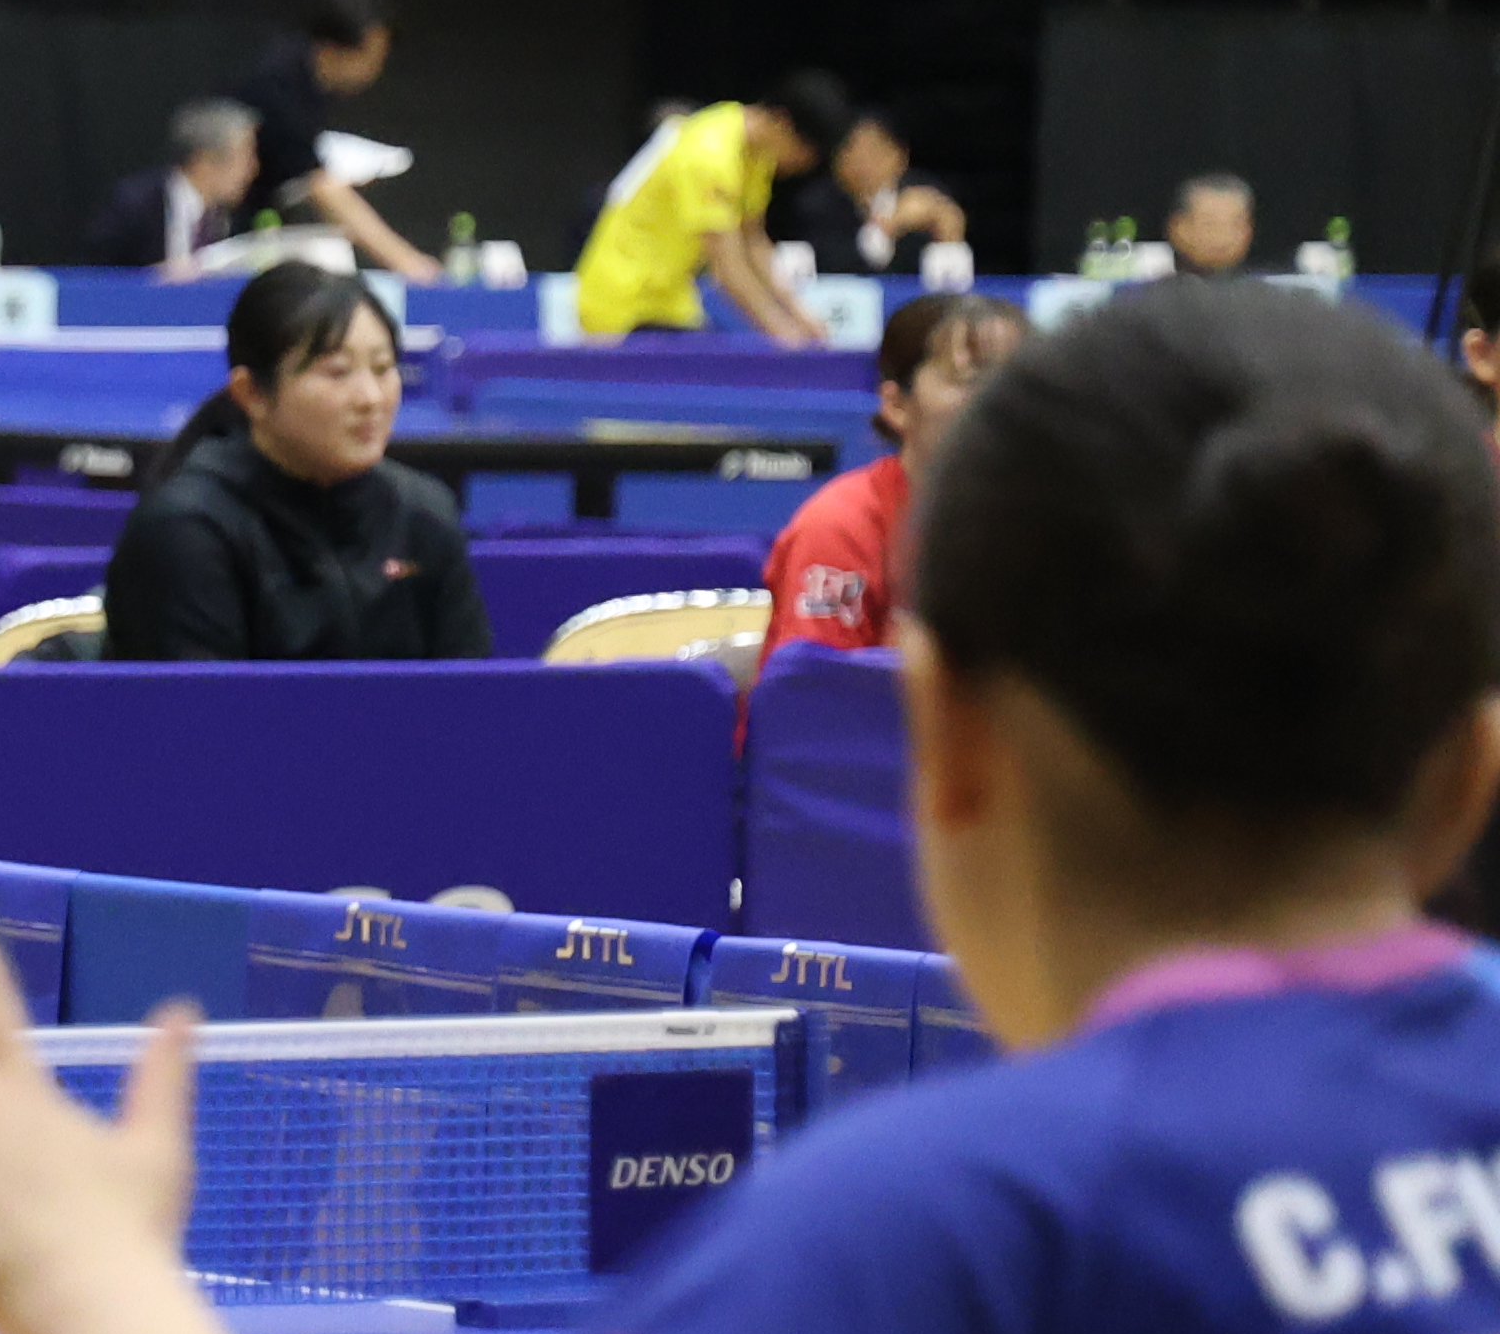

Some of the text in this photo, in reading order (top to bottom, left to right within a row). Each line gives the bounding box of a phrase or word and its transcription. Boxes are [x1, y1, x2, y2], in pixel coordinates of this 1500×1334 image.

[334, 901, 407, 949] JTTL
[556, 918, 633, 965] JTTL
[771, 942, 852, 990] JTTL
[611, 1153, 734, 1189] DENSO
